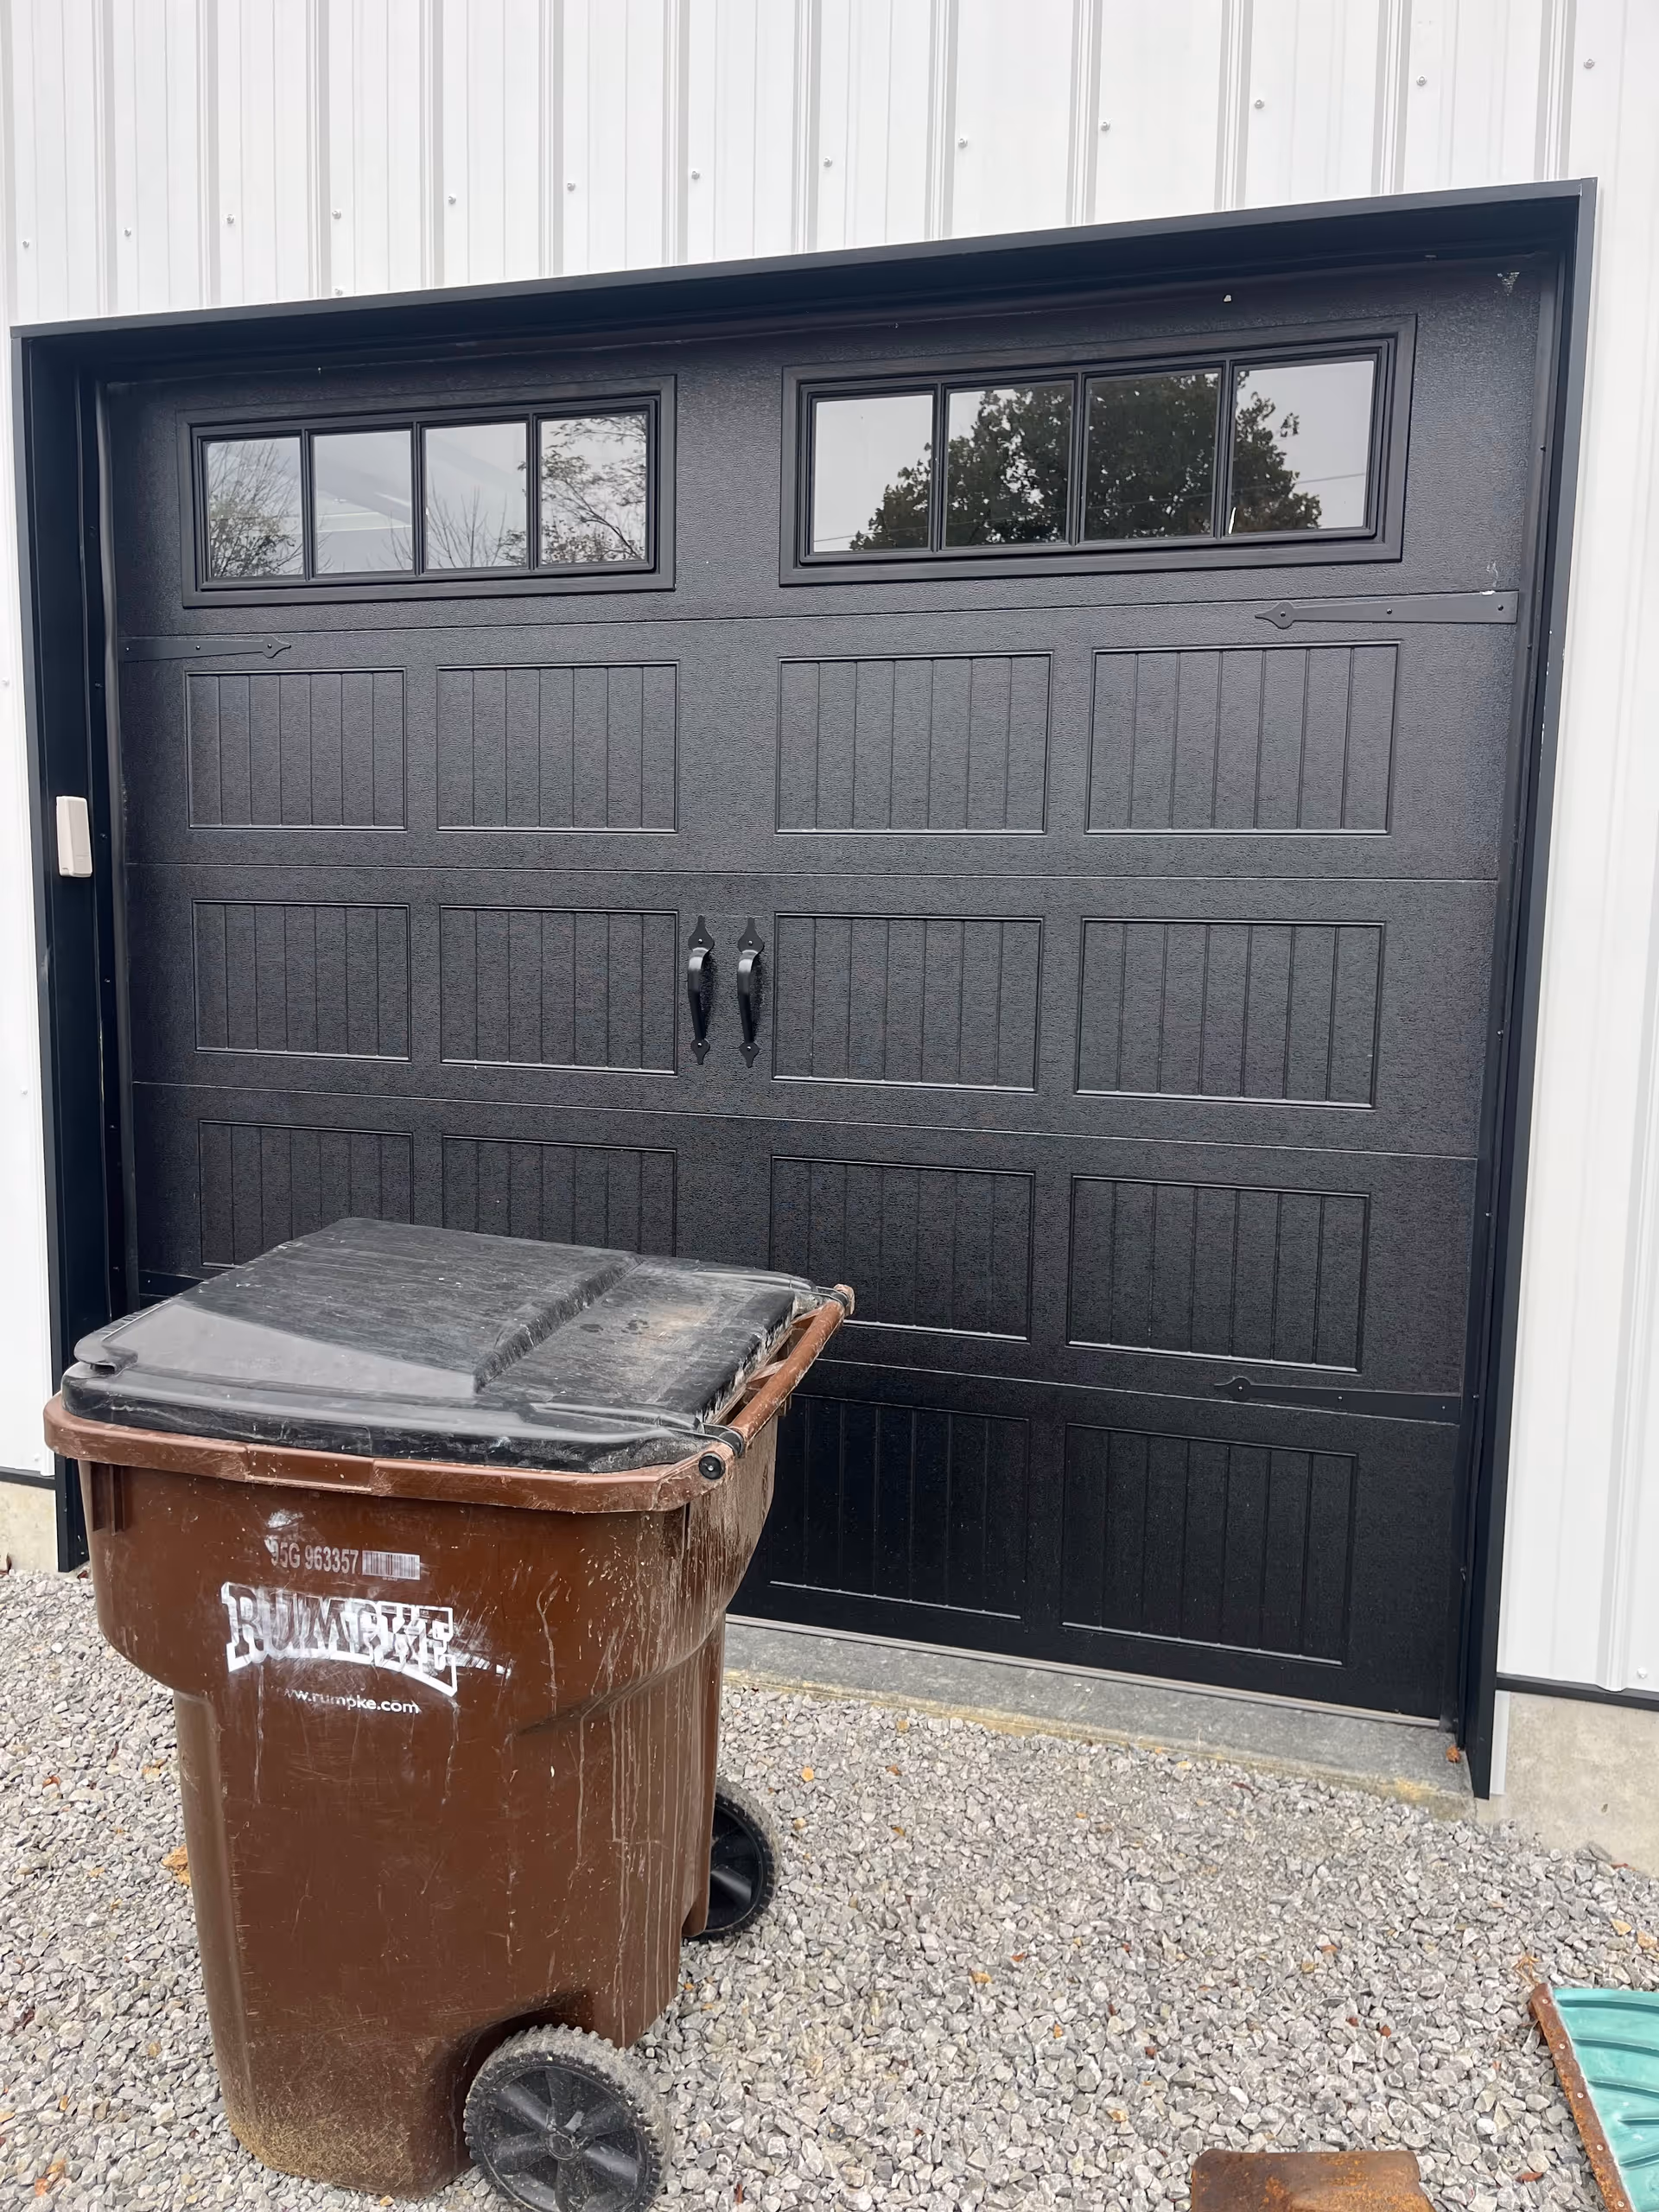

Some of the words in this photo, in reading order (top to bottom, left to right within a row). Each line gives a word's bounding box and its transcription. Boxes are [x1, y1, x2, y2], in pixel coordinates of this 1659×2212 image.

[268, 1540, 301, 1568] 95G
[304, 1544, 359, 1574] 963357
[221, 1582, 458, 1697] RUMPKE
